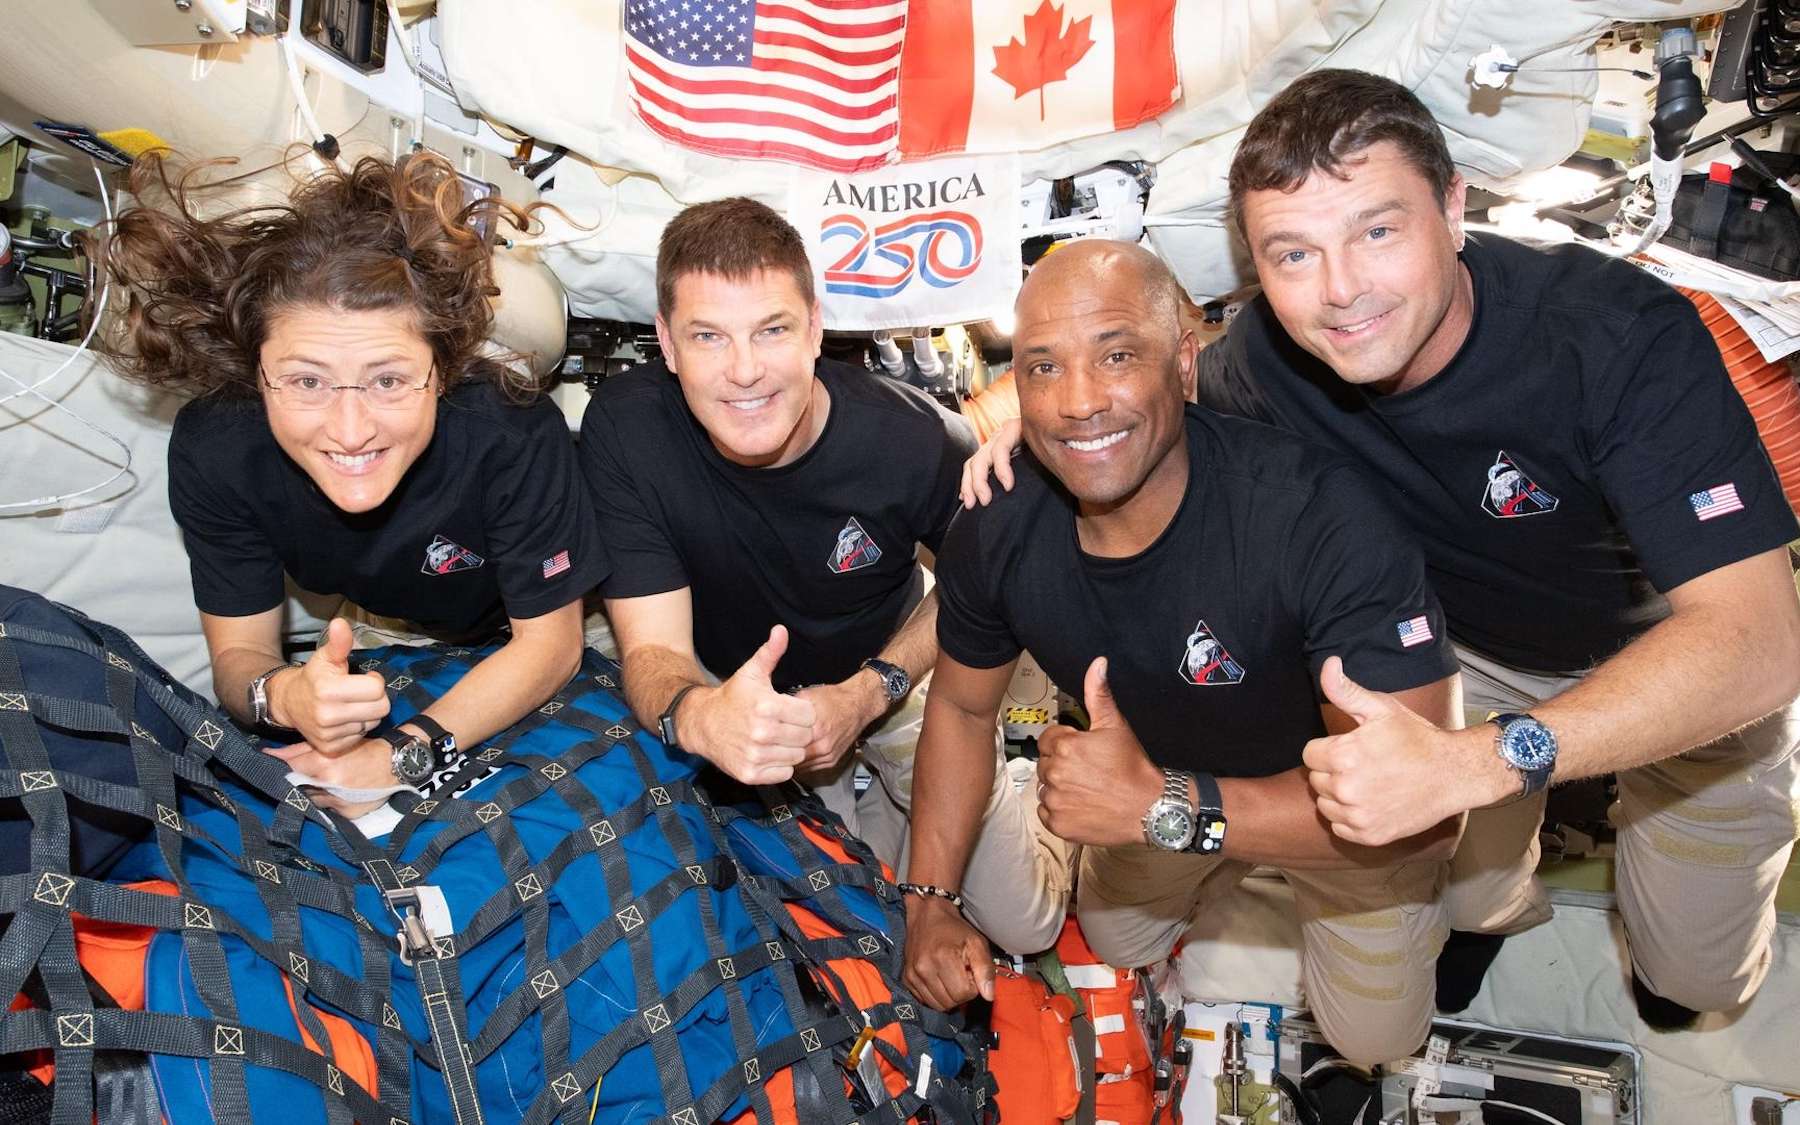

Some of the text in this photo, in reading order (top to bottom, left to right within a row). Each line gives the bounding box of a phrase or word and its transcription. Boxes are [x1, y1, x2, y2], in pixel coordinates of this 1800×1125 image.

[822, 172, 986, 213] AMERICA
[821, 211, 983, 298] 250
[1653, 266, 1674, 278] NOT
